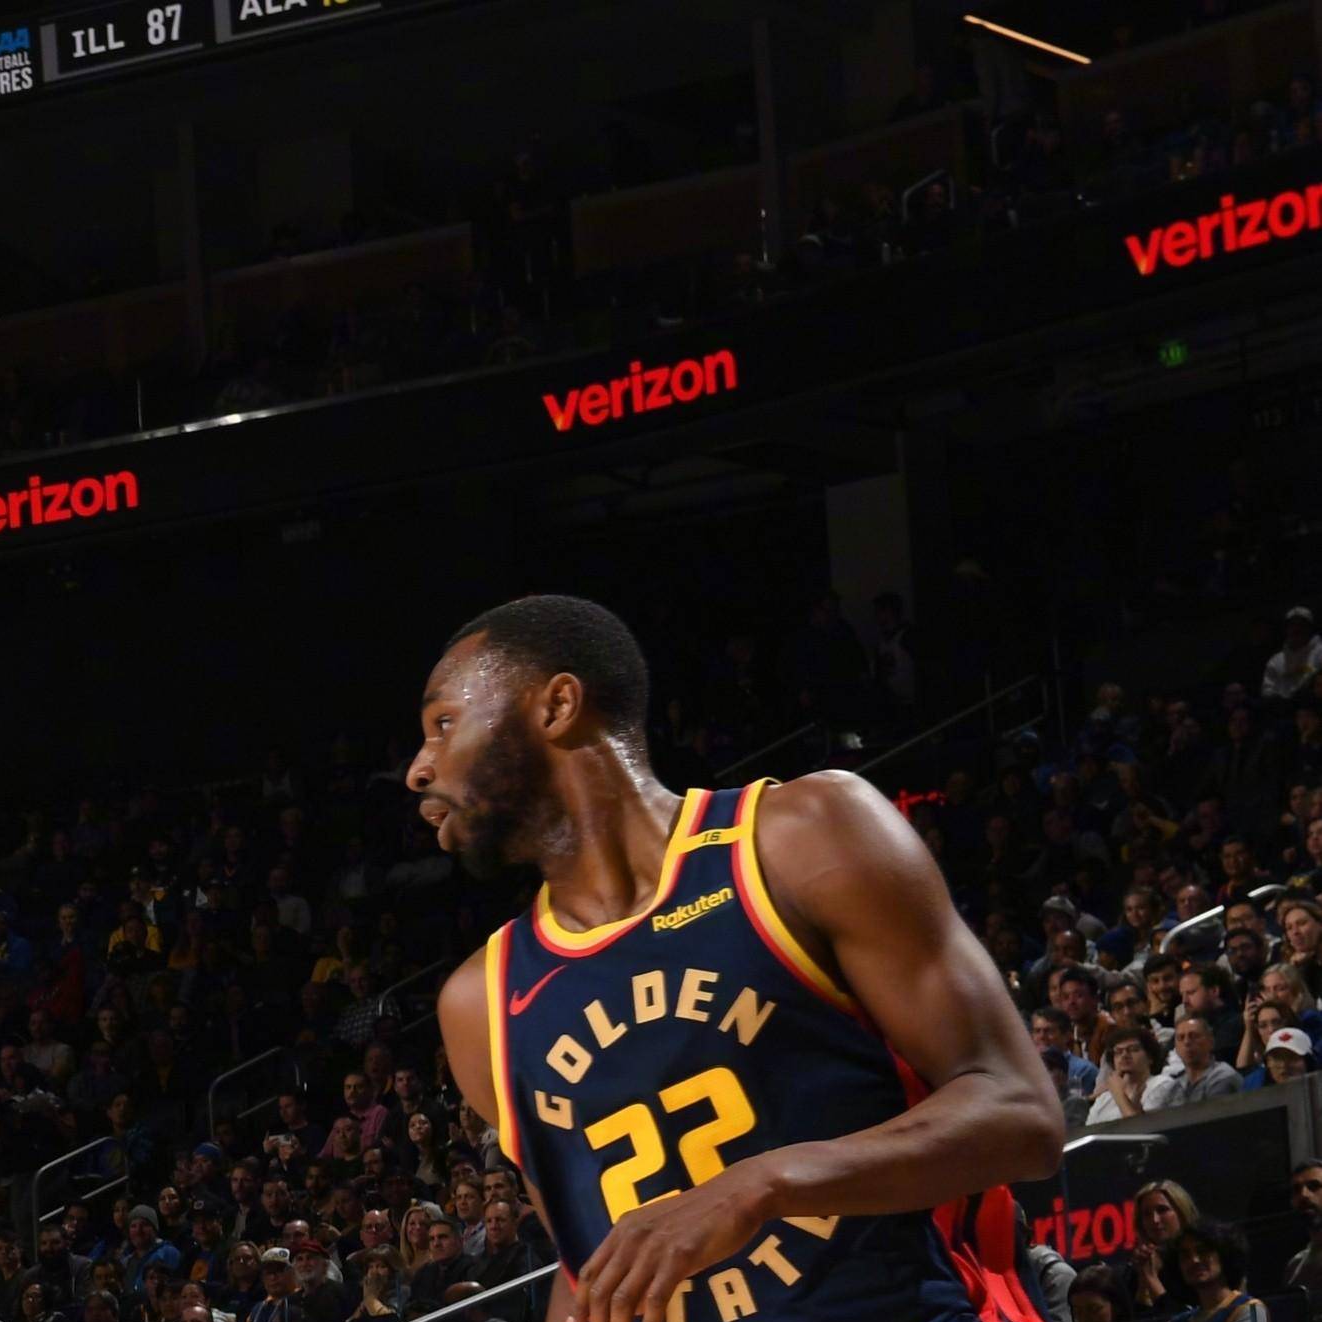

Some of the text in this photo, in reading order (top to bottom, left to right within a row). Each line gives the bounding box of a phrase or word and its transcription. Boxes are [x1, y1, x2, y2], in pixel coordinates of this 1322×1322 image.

[71, 4, 183, 58] ILL 87
[542, 349, 738, 432] verizon
[652, 887, 734, 932] Rakuten
[534, 967, 777, 1132] GOLDEN
[583, 1066, 757, 1226] 22
